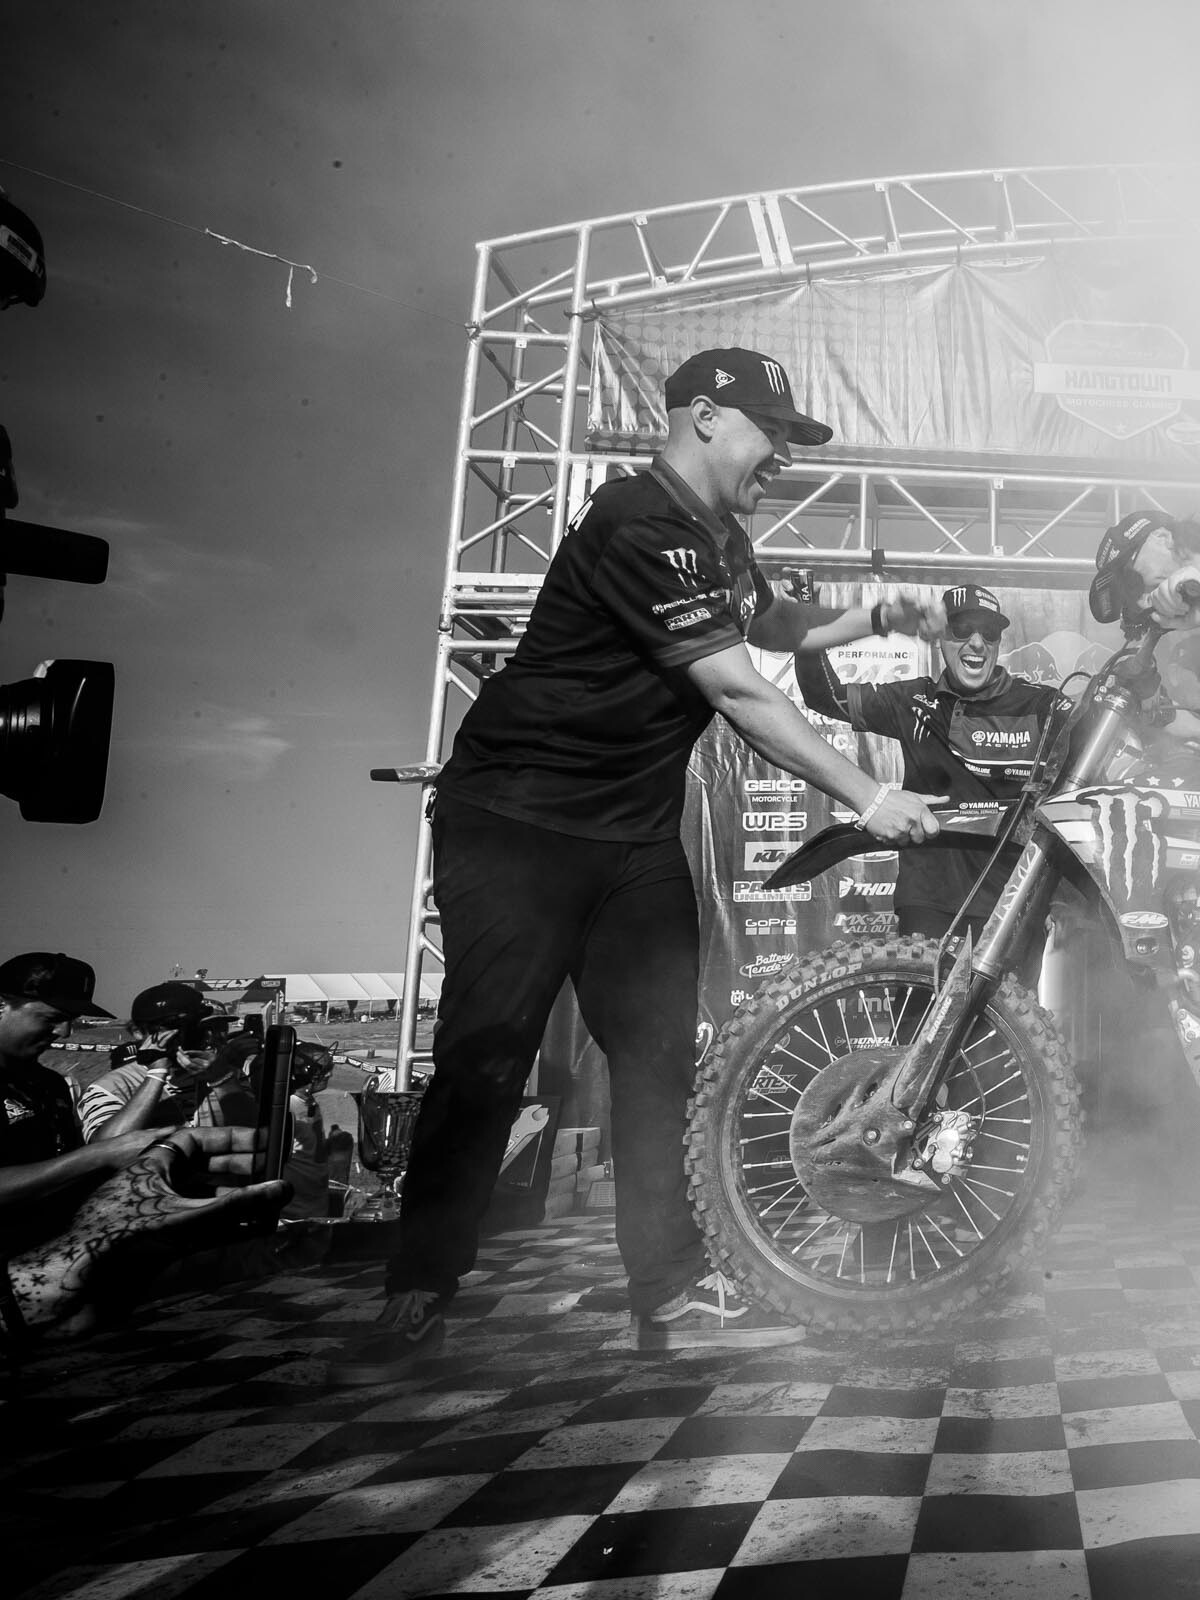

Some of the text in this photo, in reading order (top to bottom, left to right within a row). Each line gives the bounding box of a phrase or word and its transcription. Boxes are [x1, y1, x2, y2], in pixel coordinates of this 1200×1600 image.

[1065, 369, 1172, 393] HANGTOWN
[985, 730, 1031, 744] YAMAHA
[743, 780, 806, 791] GEICO
[968, 801, 999, 809] YAMAHA
[743, 812, 806, 830] WPS
[734, 893, 811, 901] UNLIMITED
[745, 918, 797, 928] GoPro
[846, 925, 892, 934] ALL OUT
[755, 953, 795, 966] Battery
[775, 962, 863, 1012] DUNLOP
